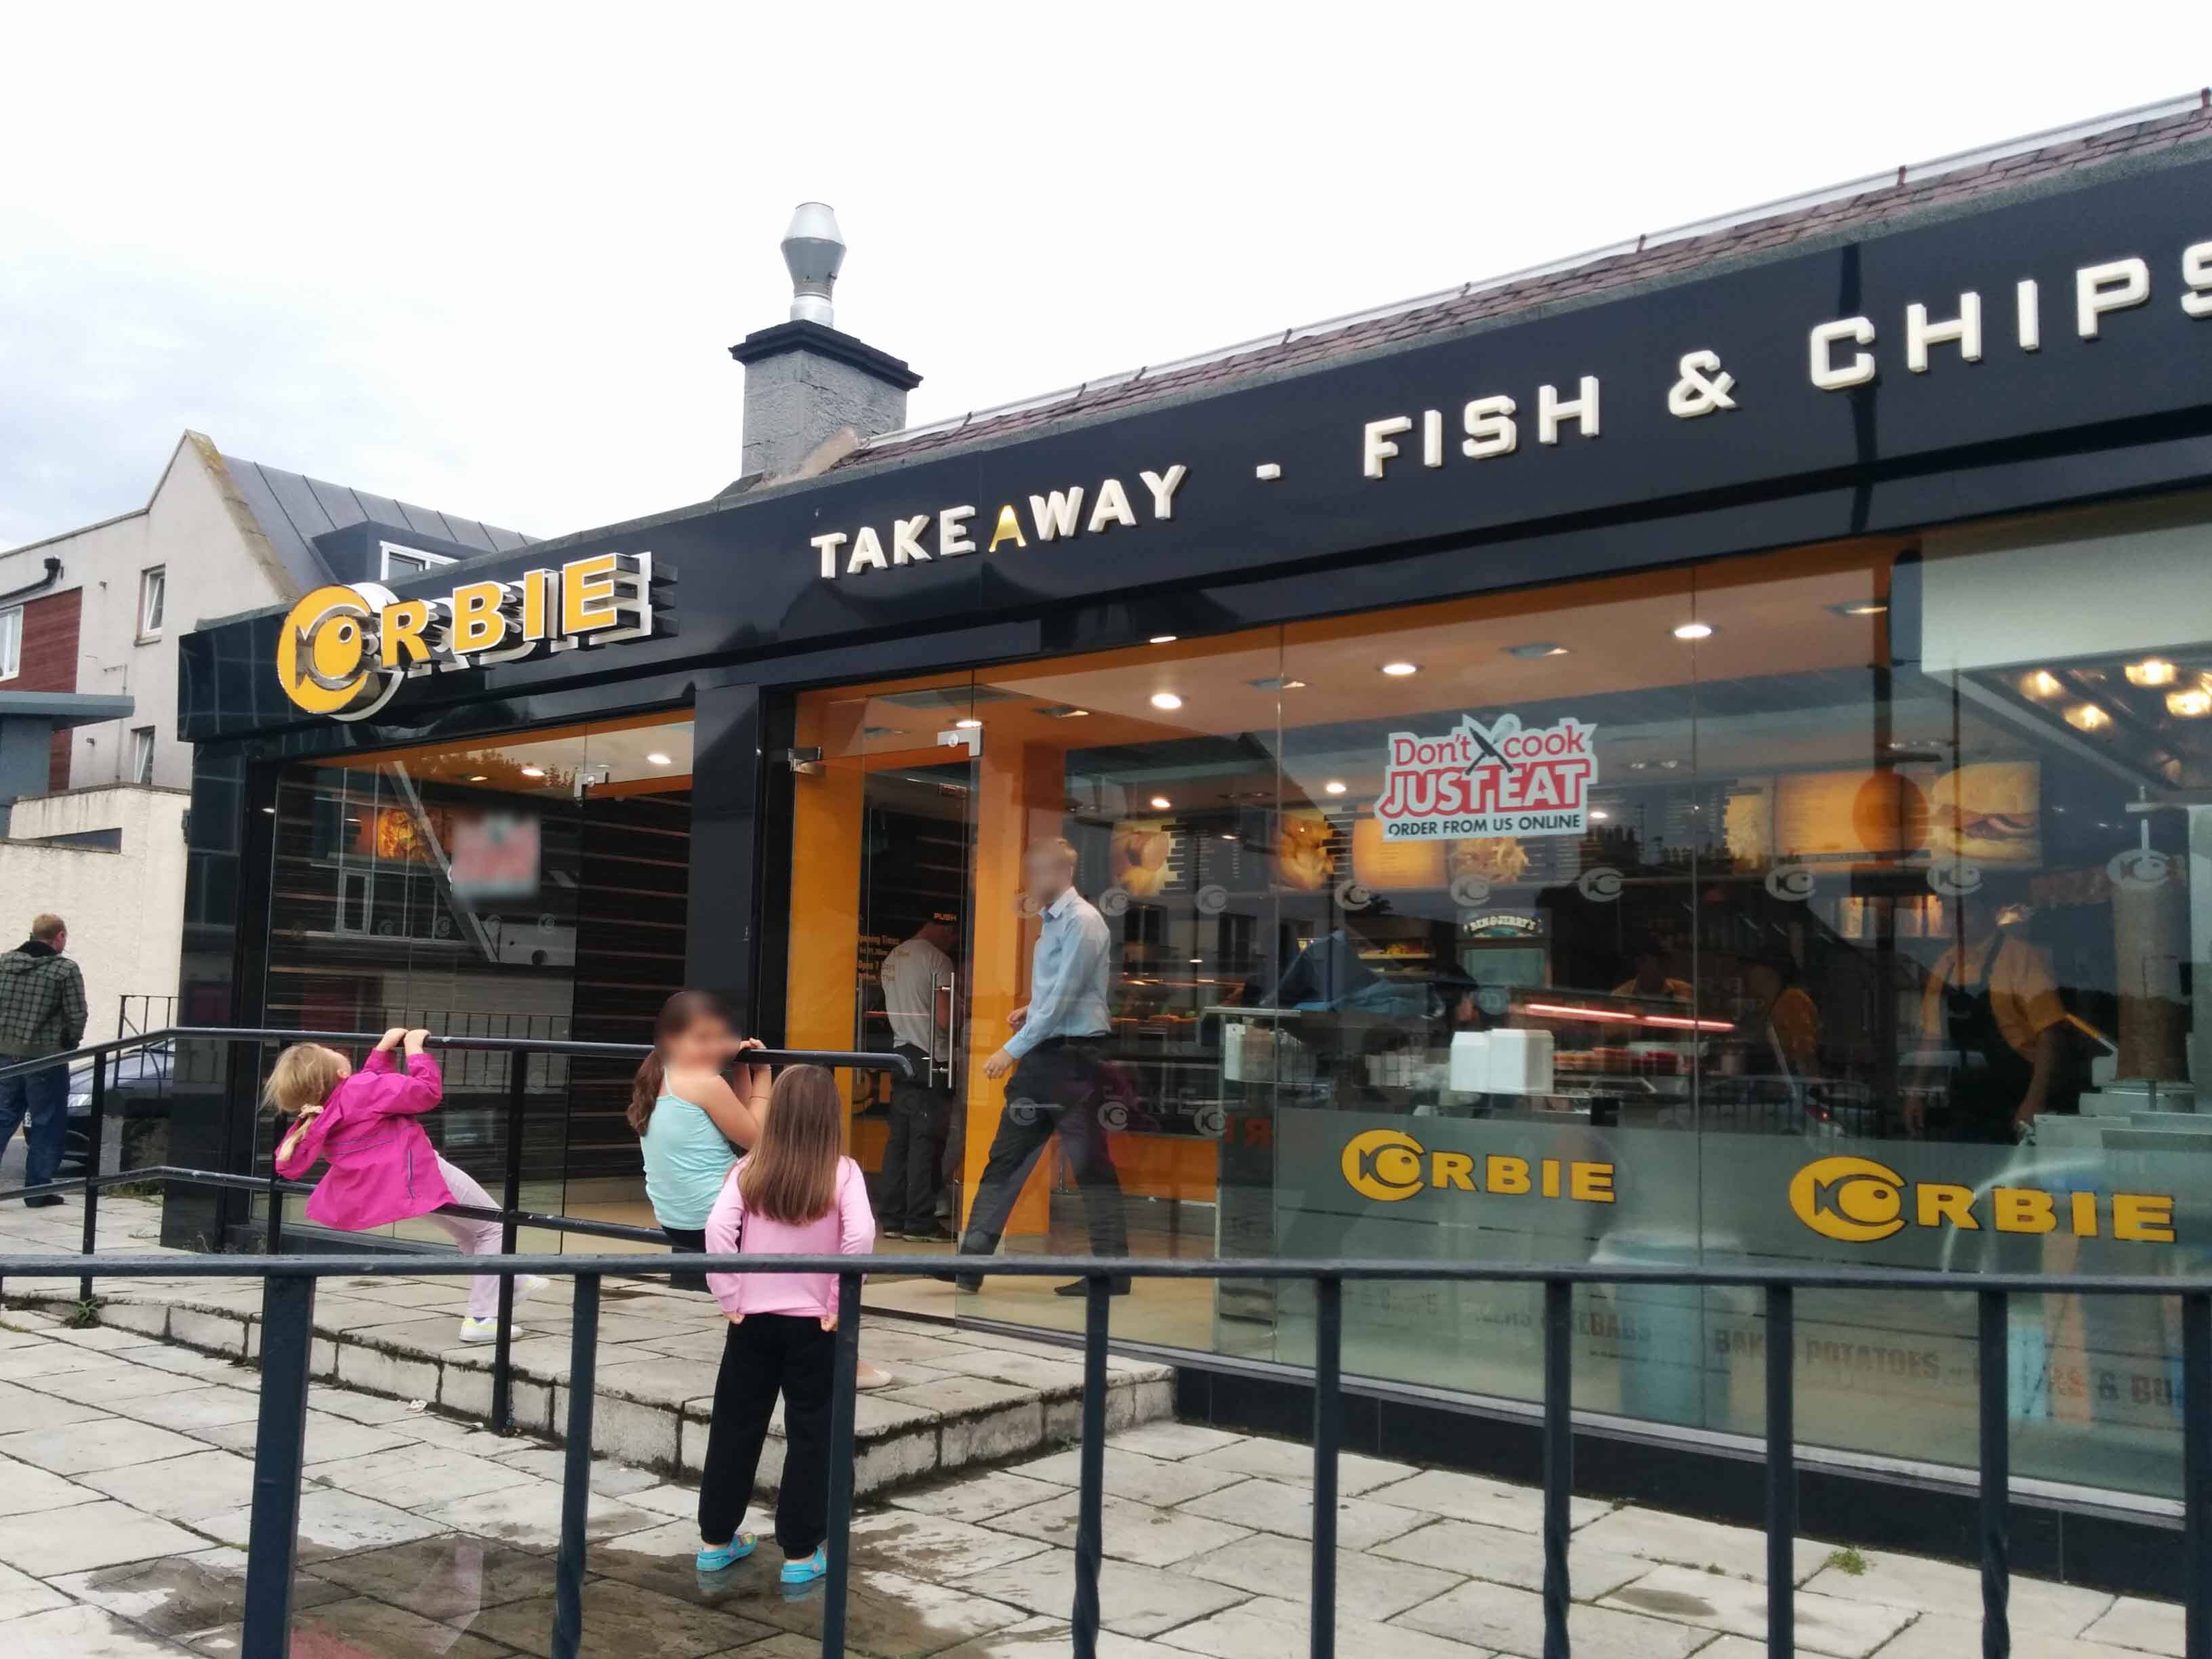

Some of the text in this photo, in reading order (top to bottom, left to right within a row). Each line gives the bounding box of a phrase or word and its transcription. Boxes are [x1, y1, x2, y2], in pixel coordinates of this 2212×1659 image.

[811, 464, 1187, 579] TAKEAWAY
[1364, 375, 1600, 478] FISH
[1667, 350, 1737, 419] &
[1394, 724, 1586, 766] Don't cook
[1389, 814, 1580, 836] ORDER FROM US ONLINE
